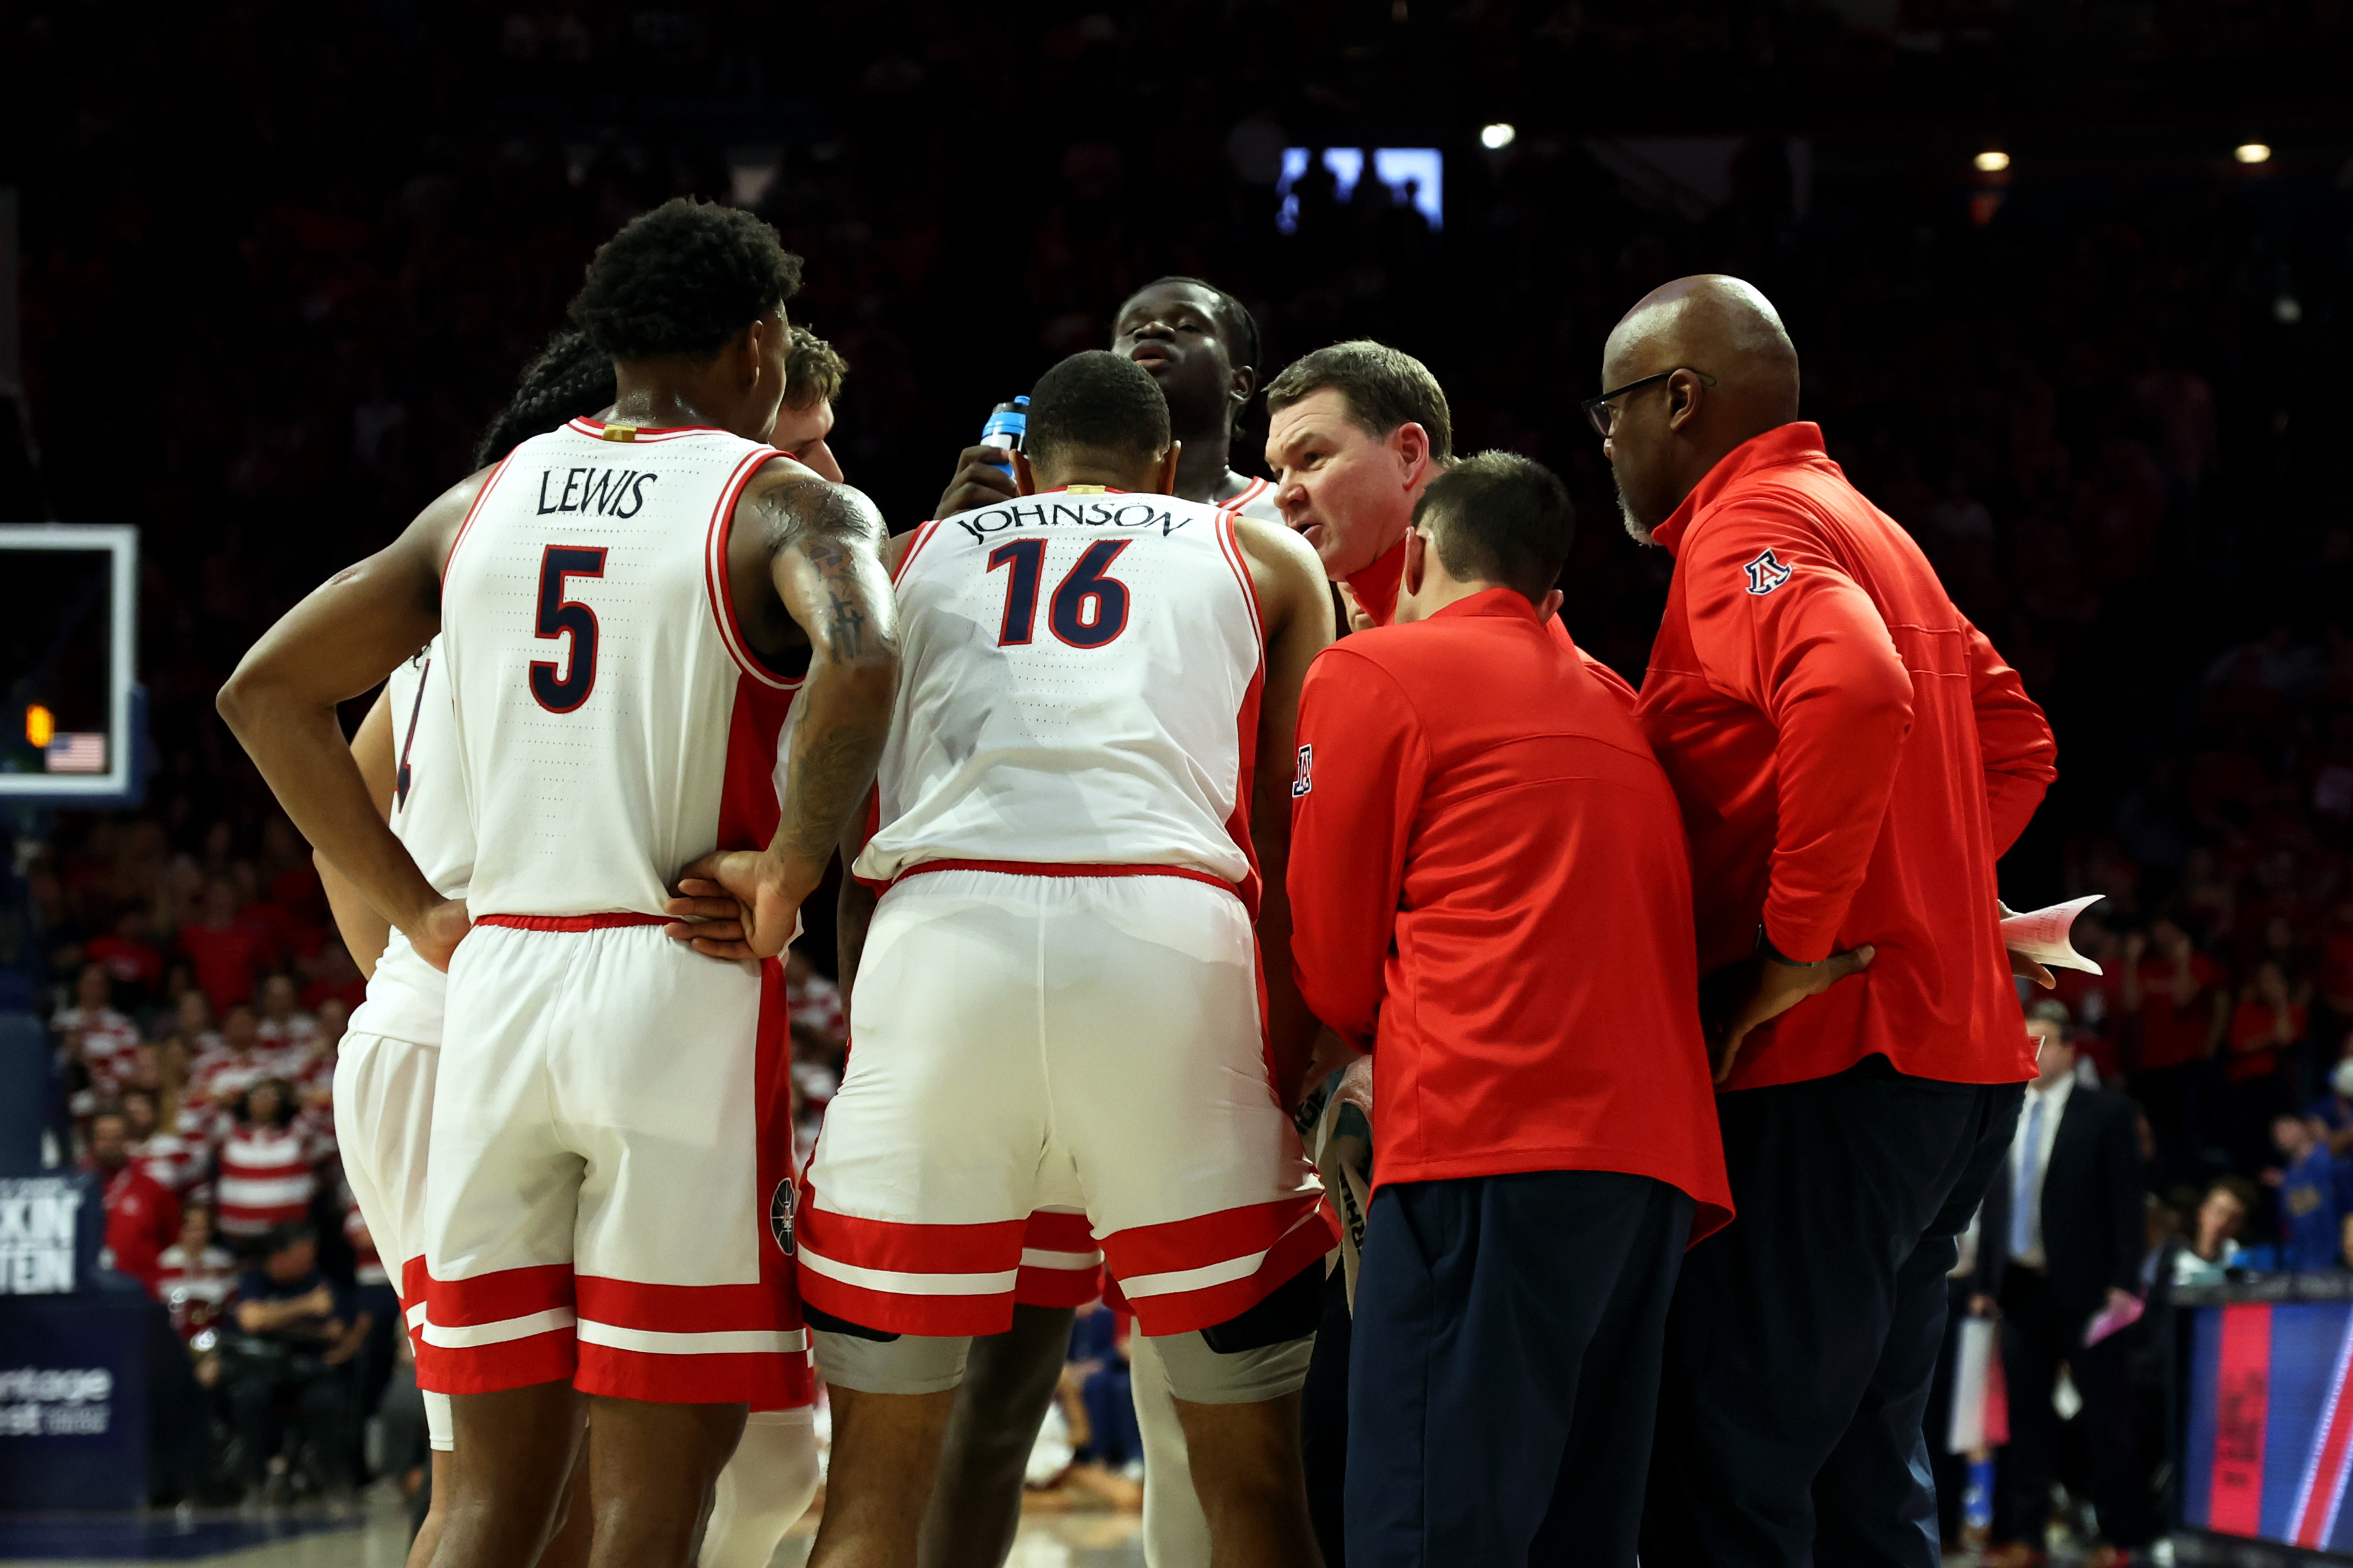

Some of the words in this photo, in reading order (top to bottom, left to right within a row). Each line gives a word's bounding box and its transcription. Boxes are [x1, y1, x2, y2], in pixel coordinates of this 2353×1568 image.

[535, 468, 658, 519] LEWIS
[957, 503, 1194, 546] JOHNSON
[986, 538, 1134, 649] 16
[1742, 546, 1794, 596] A
[528, 544, 609, 714] 5
